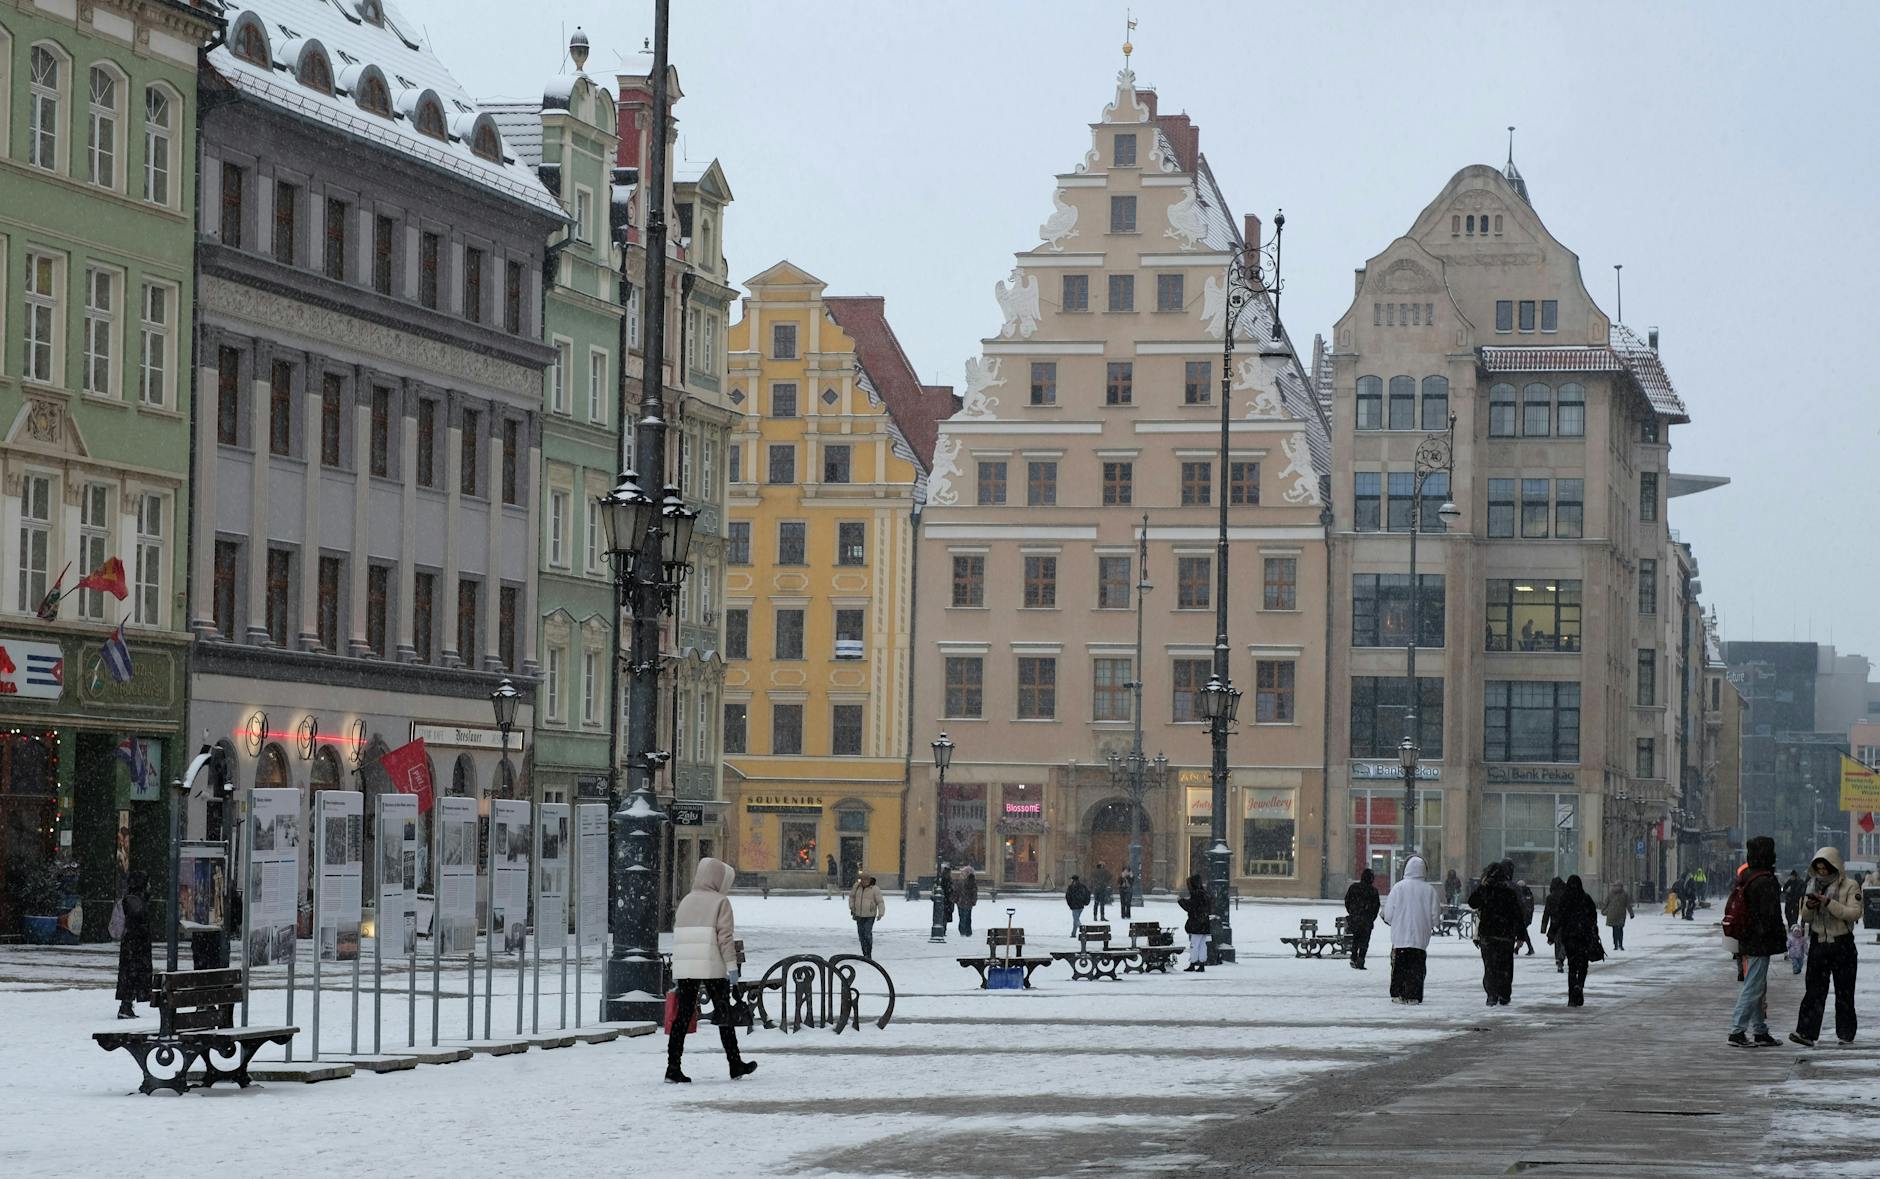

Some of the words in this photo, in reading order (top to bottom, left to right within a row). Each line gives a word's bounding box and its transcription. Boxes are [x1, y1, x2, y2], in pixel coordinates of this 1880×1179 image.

[1377, 764, 1404, 776] Bank
[1513, 767, 1539, 779] Bank
[1543, 767, 1574, 780] Pekao
[747, 796, 822, 806] SOUVENIRS
[1247, 791, 1292, 811] Jewellery
